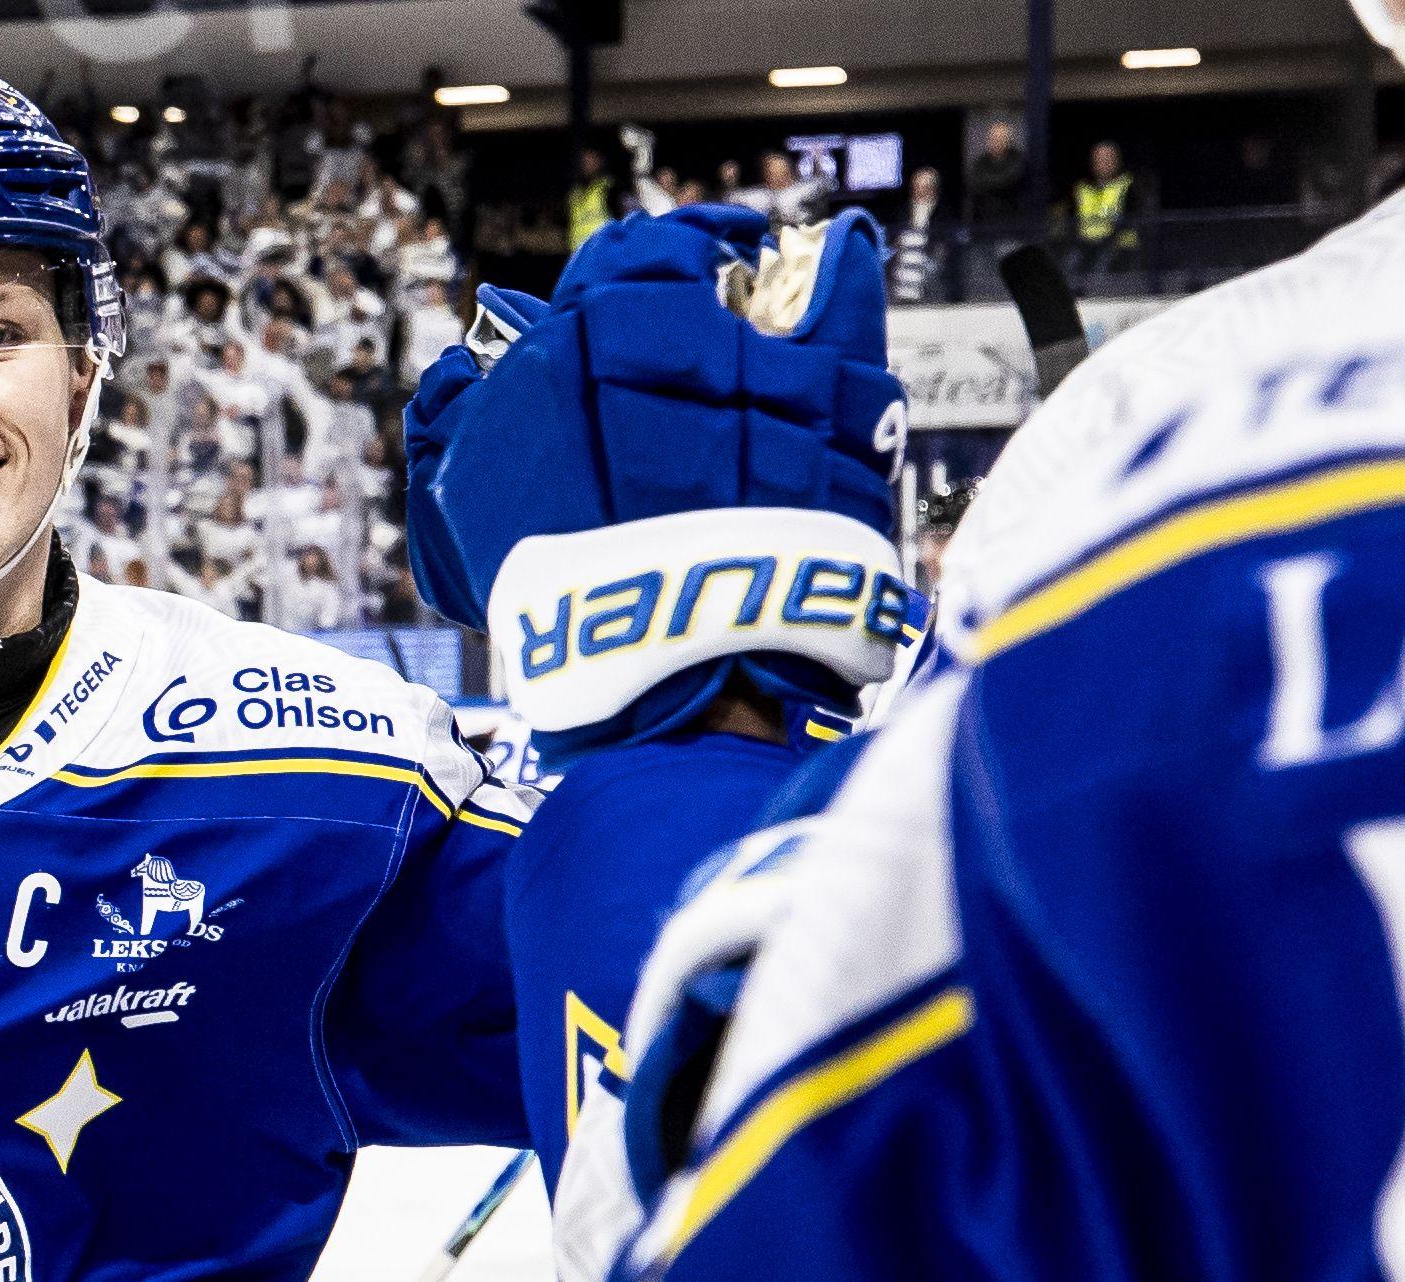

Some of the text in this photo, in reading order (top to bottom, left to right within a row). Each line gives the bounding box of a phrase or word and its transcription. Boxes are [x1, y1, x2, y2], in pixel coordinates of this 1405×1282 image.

[49, 650, 123, 725] TEGERA
[233, 666, 337, 694] Clas
[236, 697, 395, 738] Ohlson
[6, 871, 62, 968] C
